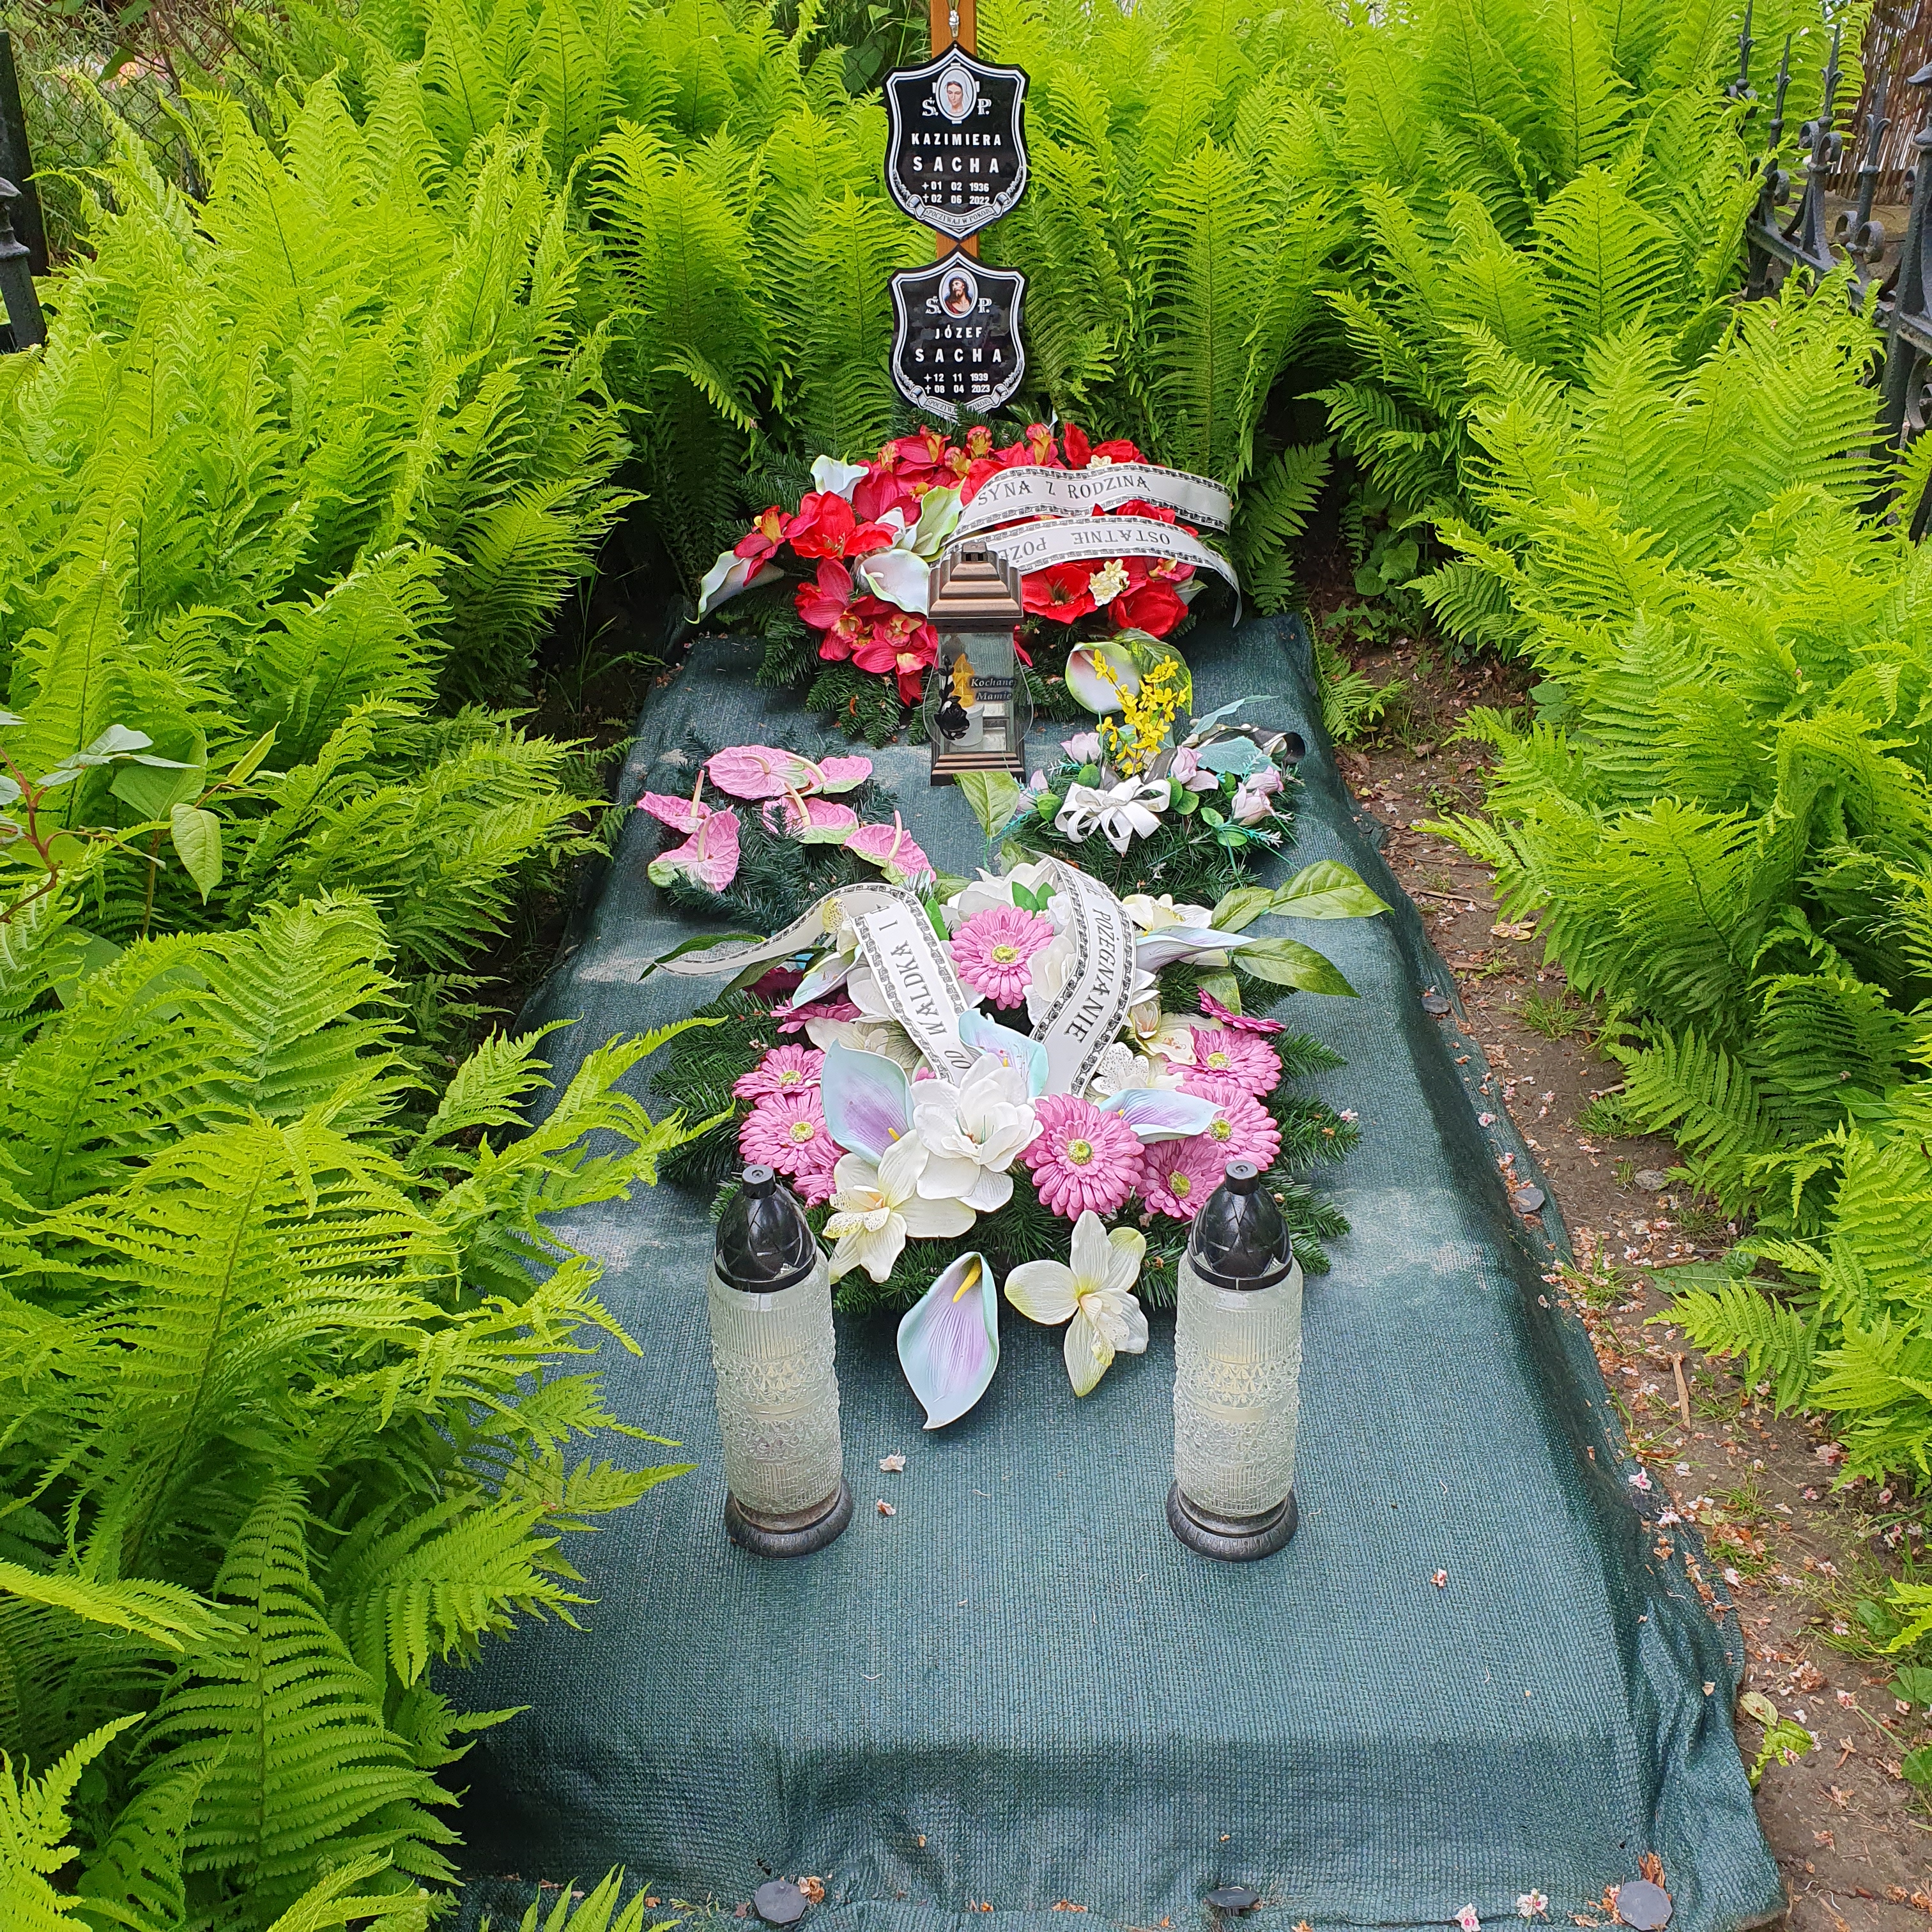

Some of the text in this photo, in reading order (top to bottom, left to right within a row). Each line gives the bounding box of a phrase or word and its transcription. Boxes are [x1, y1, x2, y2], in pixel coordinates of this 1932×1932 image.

[911, 133, 1001, 146] KAZIMIERA
[912, 156, 999, 174] SACHA
[950, 181, 962, 191] 02
[969, 182, 990, 192] 1936
[950, 194, 962, 204] 06
[969, 195, 990, 205] 2022
[935, 325, 983, 339] JÓZEF
[915, 348, 1002, 363] SACHA
[952, 372, 962, 382] 11
[970, 372, 988, 382] 1939
[953, 385, 964, 394] 04
[971, 385, 990, 394] 2023
[928, 399, 958, 414] SPOCZYWA
[977, 475, 1151, 506] SYNA Z RODZINĄ
[1071, 529, 1170, 546] OSTATNIE
[976, 691, 1011, 700] Mamie
[1063, 908, 1119, 1043] POŻEGNANIE
[891, 940, 947, 1035] WALDKA
[944, 1050, 971, 1070] OD
